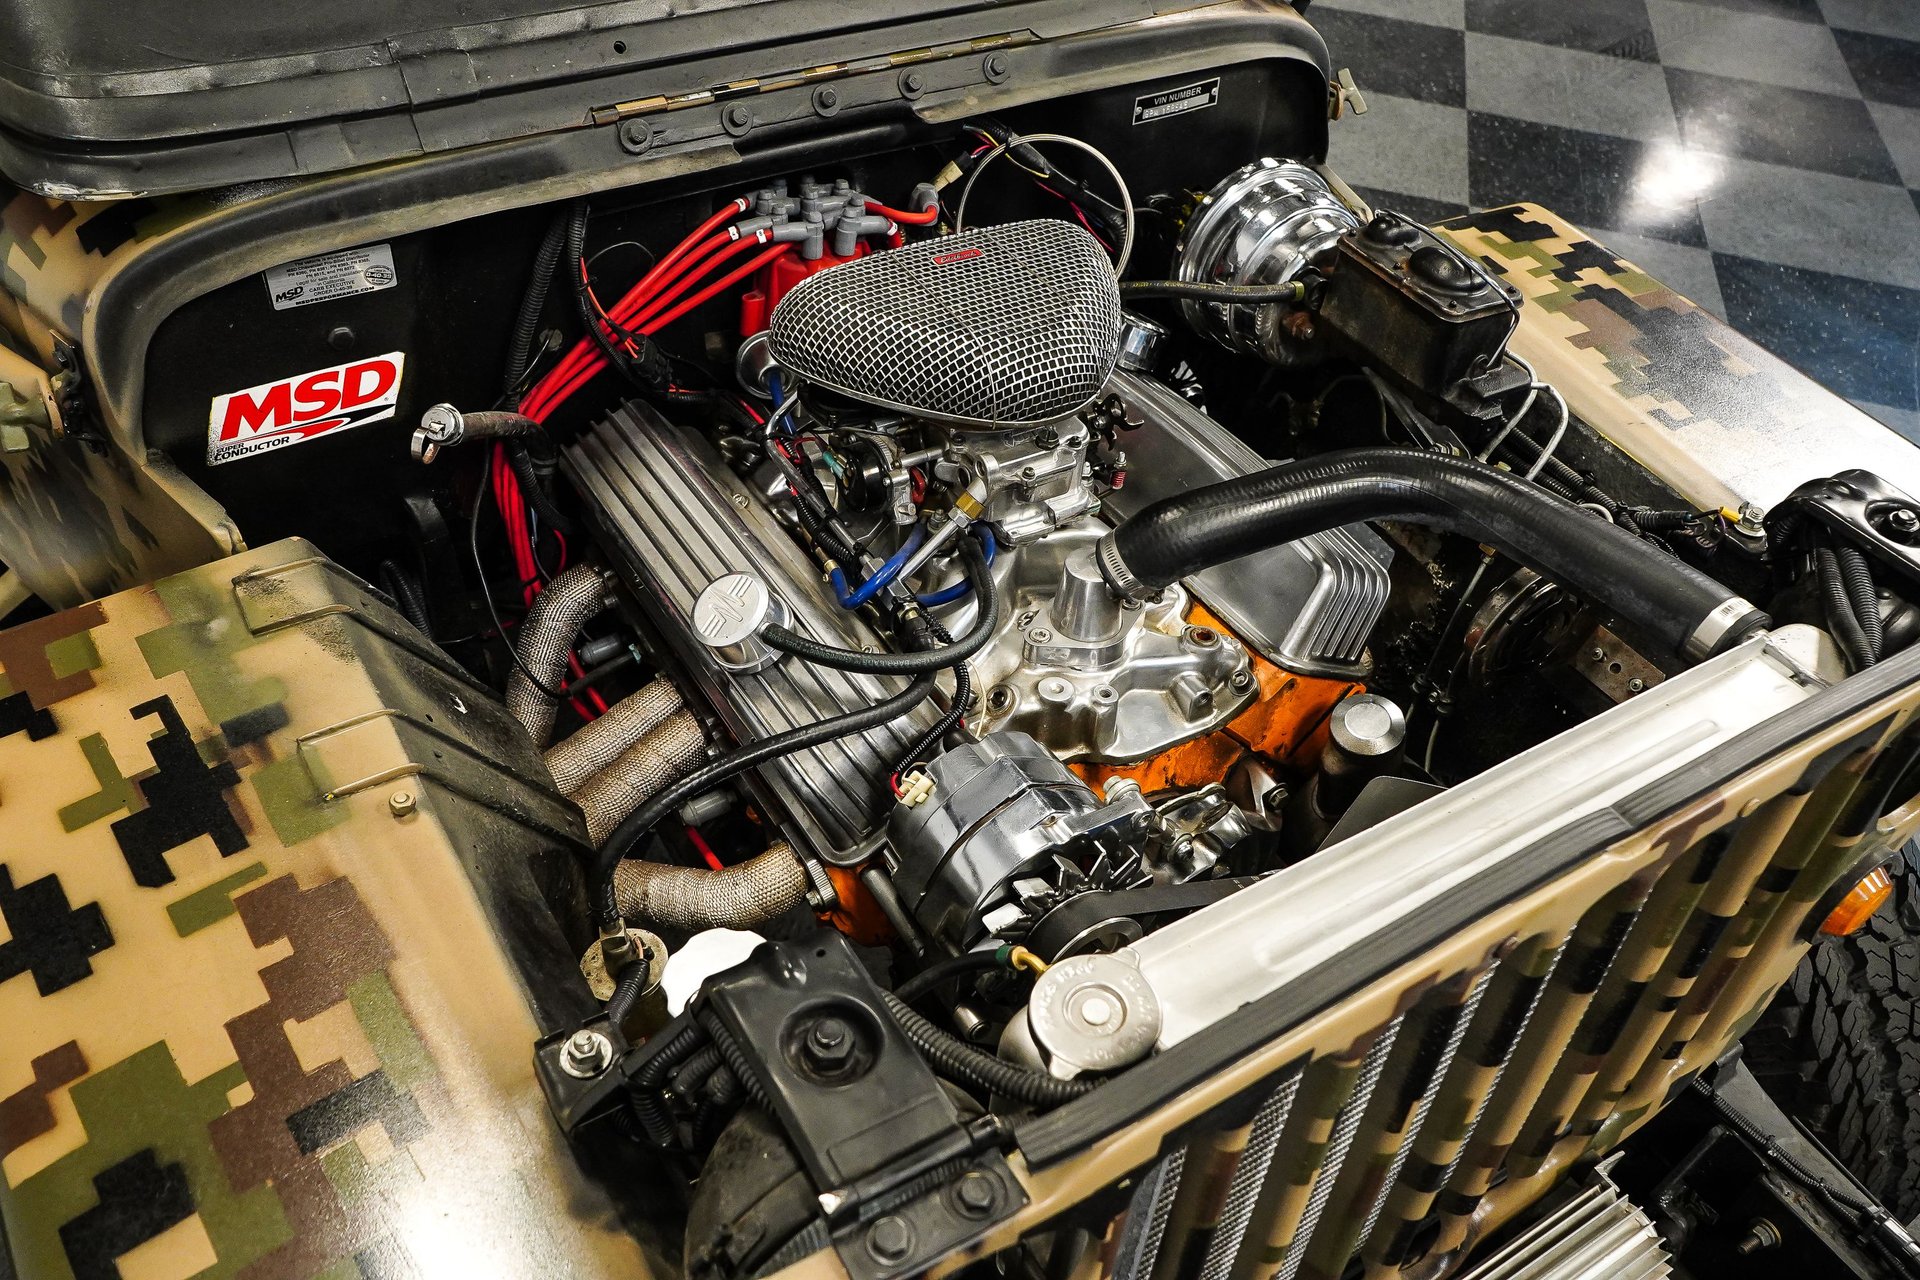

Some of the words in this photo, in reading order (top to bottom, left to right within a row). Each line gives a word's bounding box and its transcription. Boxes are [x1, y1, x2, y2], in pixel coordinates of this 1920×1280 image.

[1155, 97, 1167, 105] VIN
[1169, 87, 1202, 102] NUMBER
[325, 279, 355, 289] EXECUTIVE
[276, 286, 304, 303] MSD
[295, 286, 374, 305] MSDPERFORMANCE.COM
[220, 360, 397, 441] MSD
[214, 437, 291, 461] CONDUCTOR
[216, 443, 245, 453] SUPER
